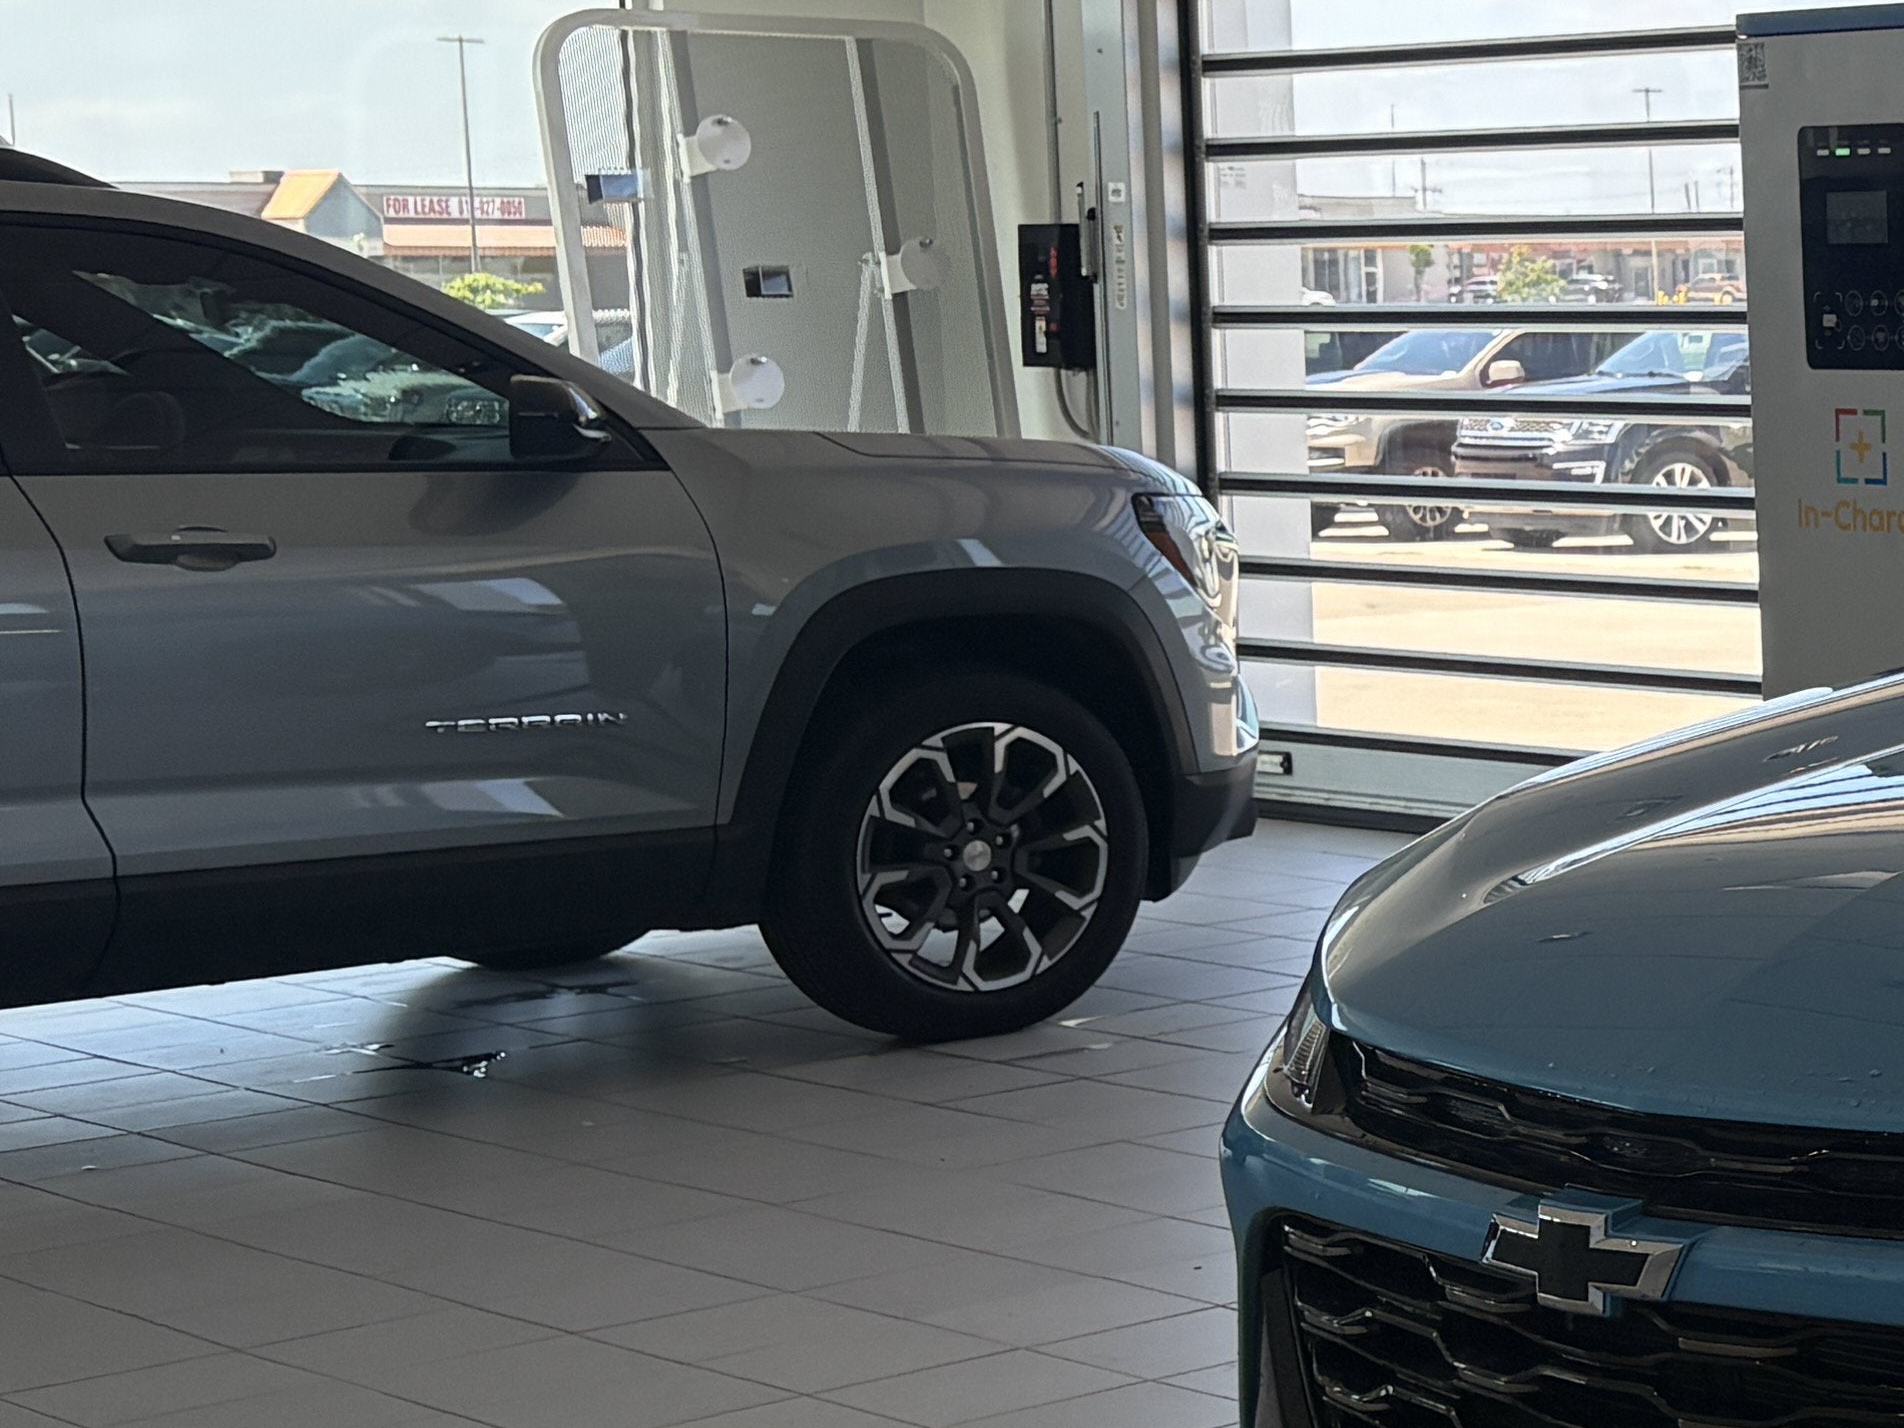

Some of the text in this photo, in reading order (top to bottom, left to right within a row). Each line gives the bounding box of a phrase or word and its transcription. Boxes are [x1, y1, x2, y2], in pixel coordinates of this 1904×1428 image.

[385, 197, 409, 215] FOR
[414, 198, 451, 216] LEASE
[425, 713, 627, 733] TERRAIN
